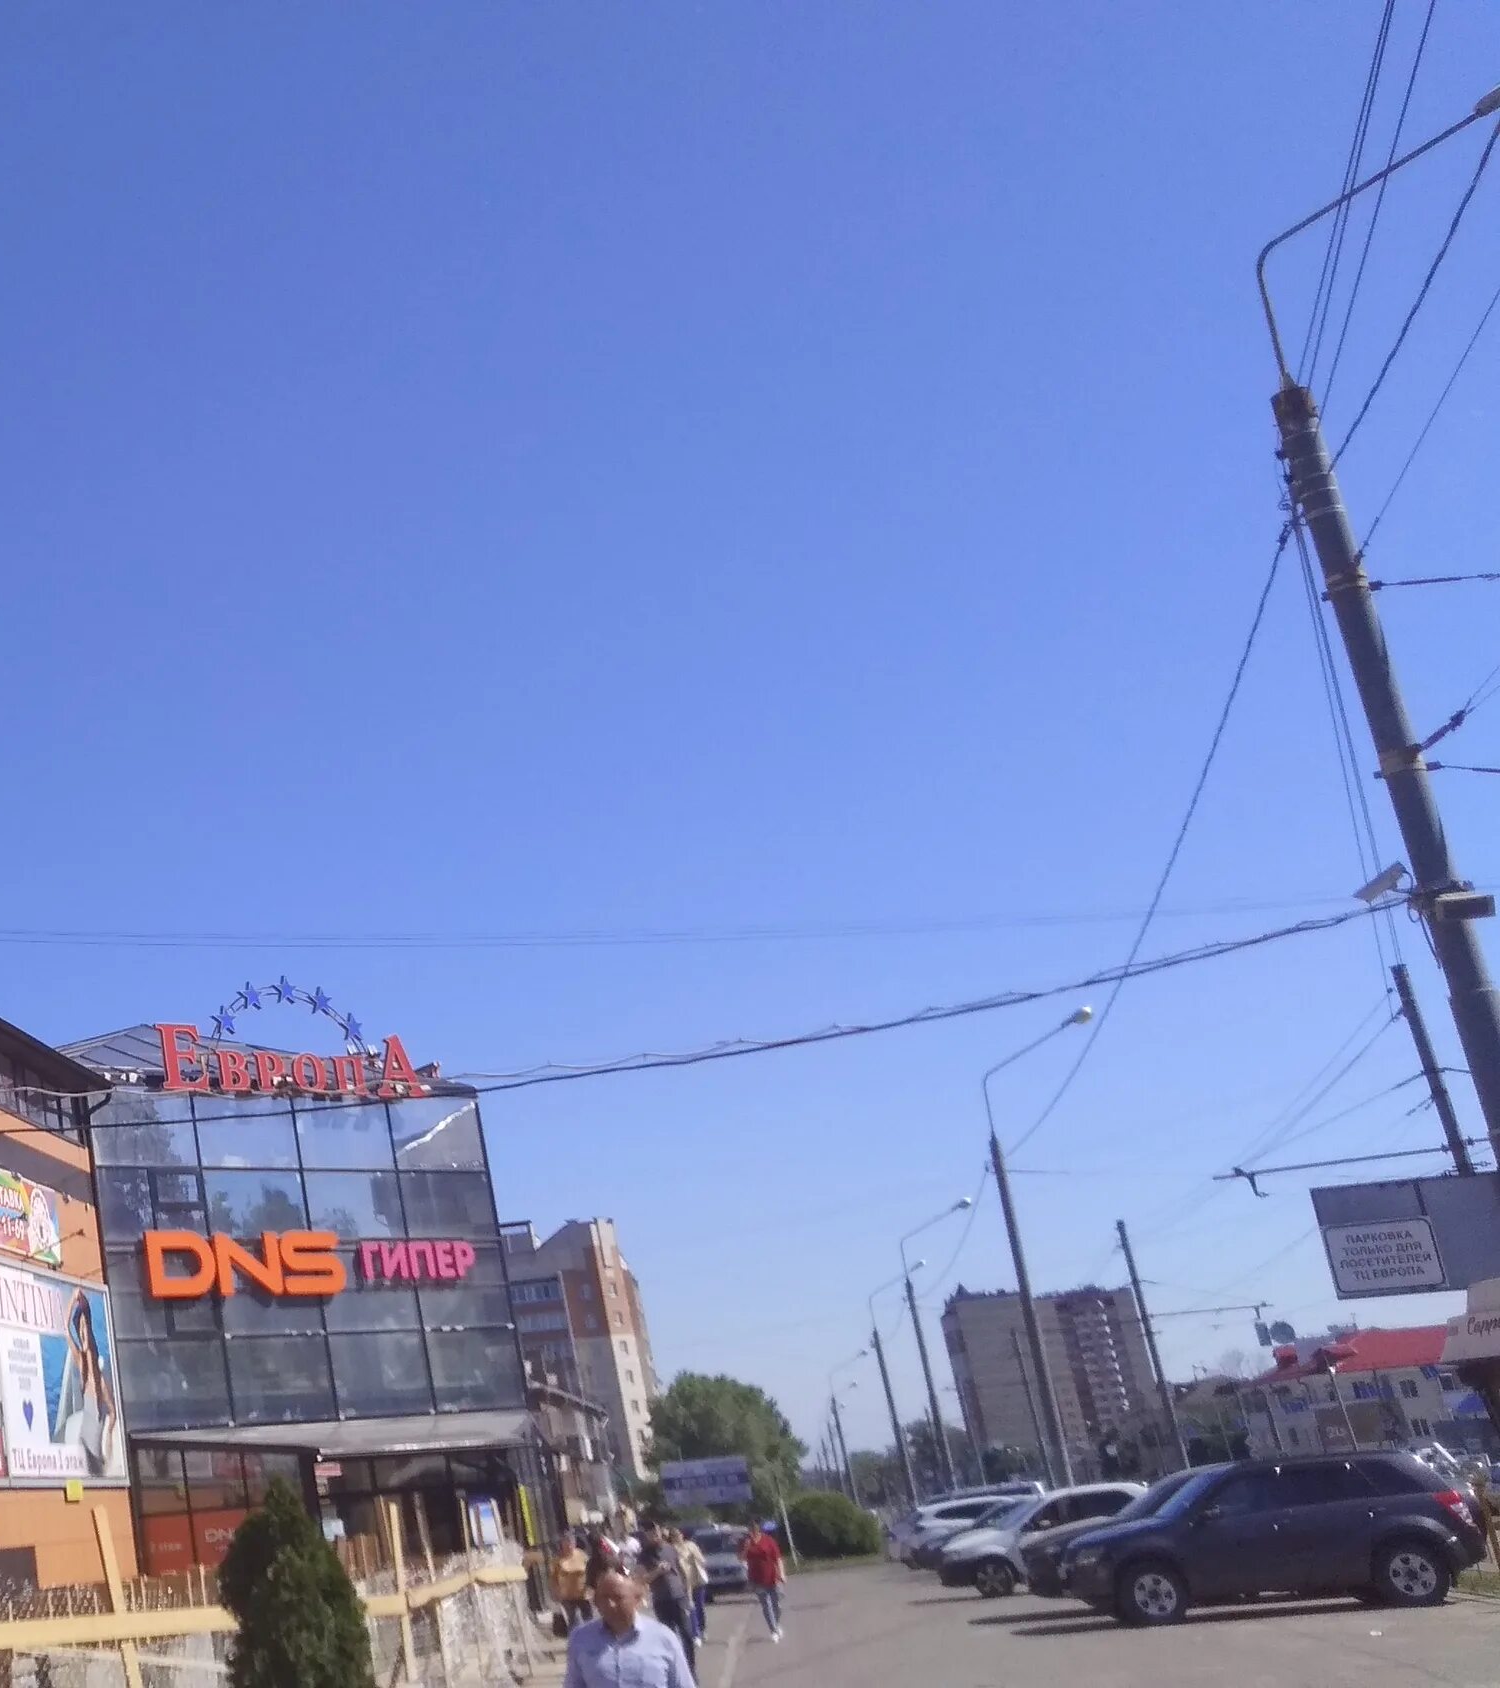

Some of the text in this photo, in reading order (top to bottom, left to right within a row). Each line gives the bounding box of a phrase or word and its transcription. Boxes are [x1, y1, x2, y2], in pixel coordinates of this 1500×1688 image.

[1345, 1230, 1413, 1244] ПАРКОВКА
[1342, 1241, 1422, 1256] ТОЛЬКО ДЛЯ
[143, 1229, 347, 1299] DNS
[357, 1240, 475, 1281] ГИПЕР
[1373, 1266, 1425, 1279] ЕВРОПА
[204, 1527, 237, 1544] DN
